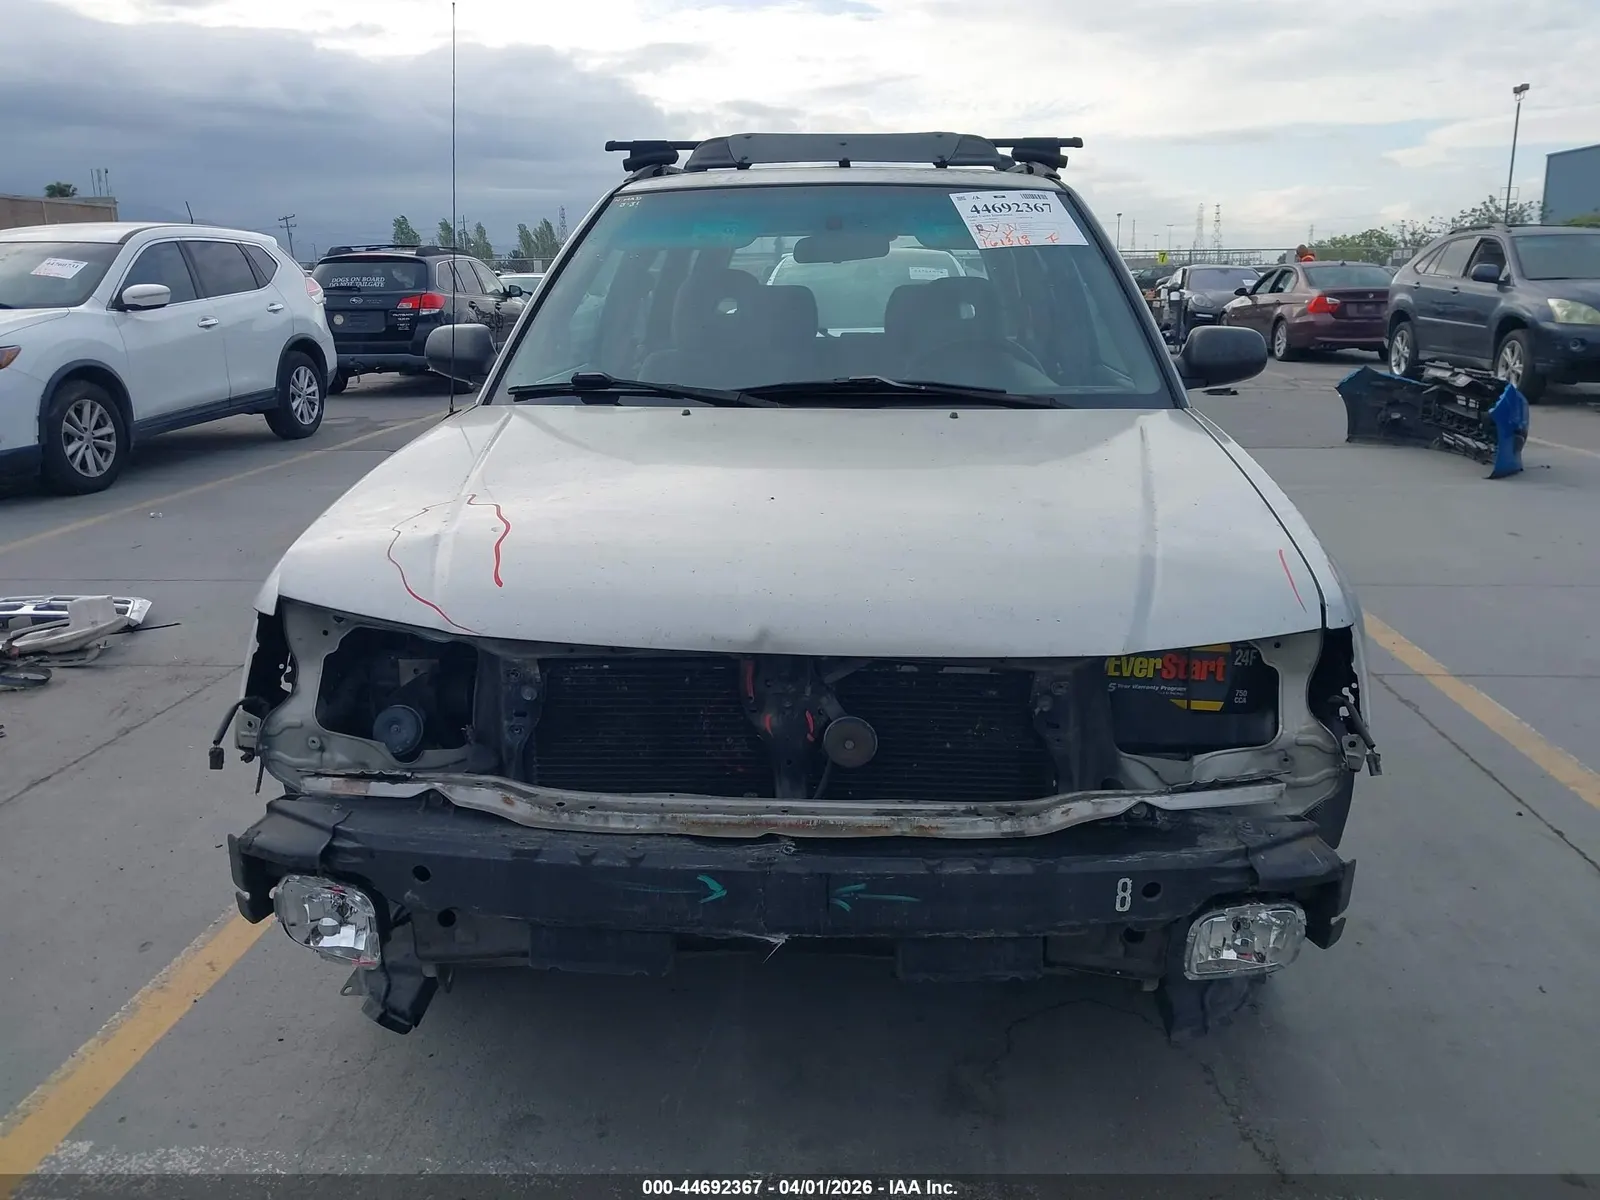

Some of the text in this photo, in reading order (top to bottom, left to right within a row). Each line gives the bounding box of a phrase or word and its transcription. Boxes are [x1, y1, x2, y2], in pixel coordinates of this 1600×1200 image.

[970, 202, 1052, 214] 44692367
[1159, 252, 1166, 263] 7
[1105, 649, 1257, 682] EverStart 24F
[1107, 682, 1117, 692] 5
[1115, 877, 1132, 912] 8
